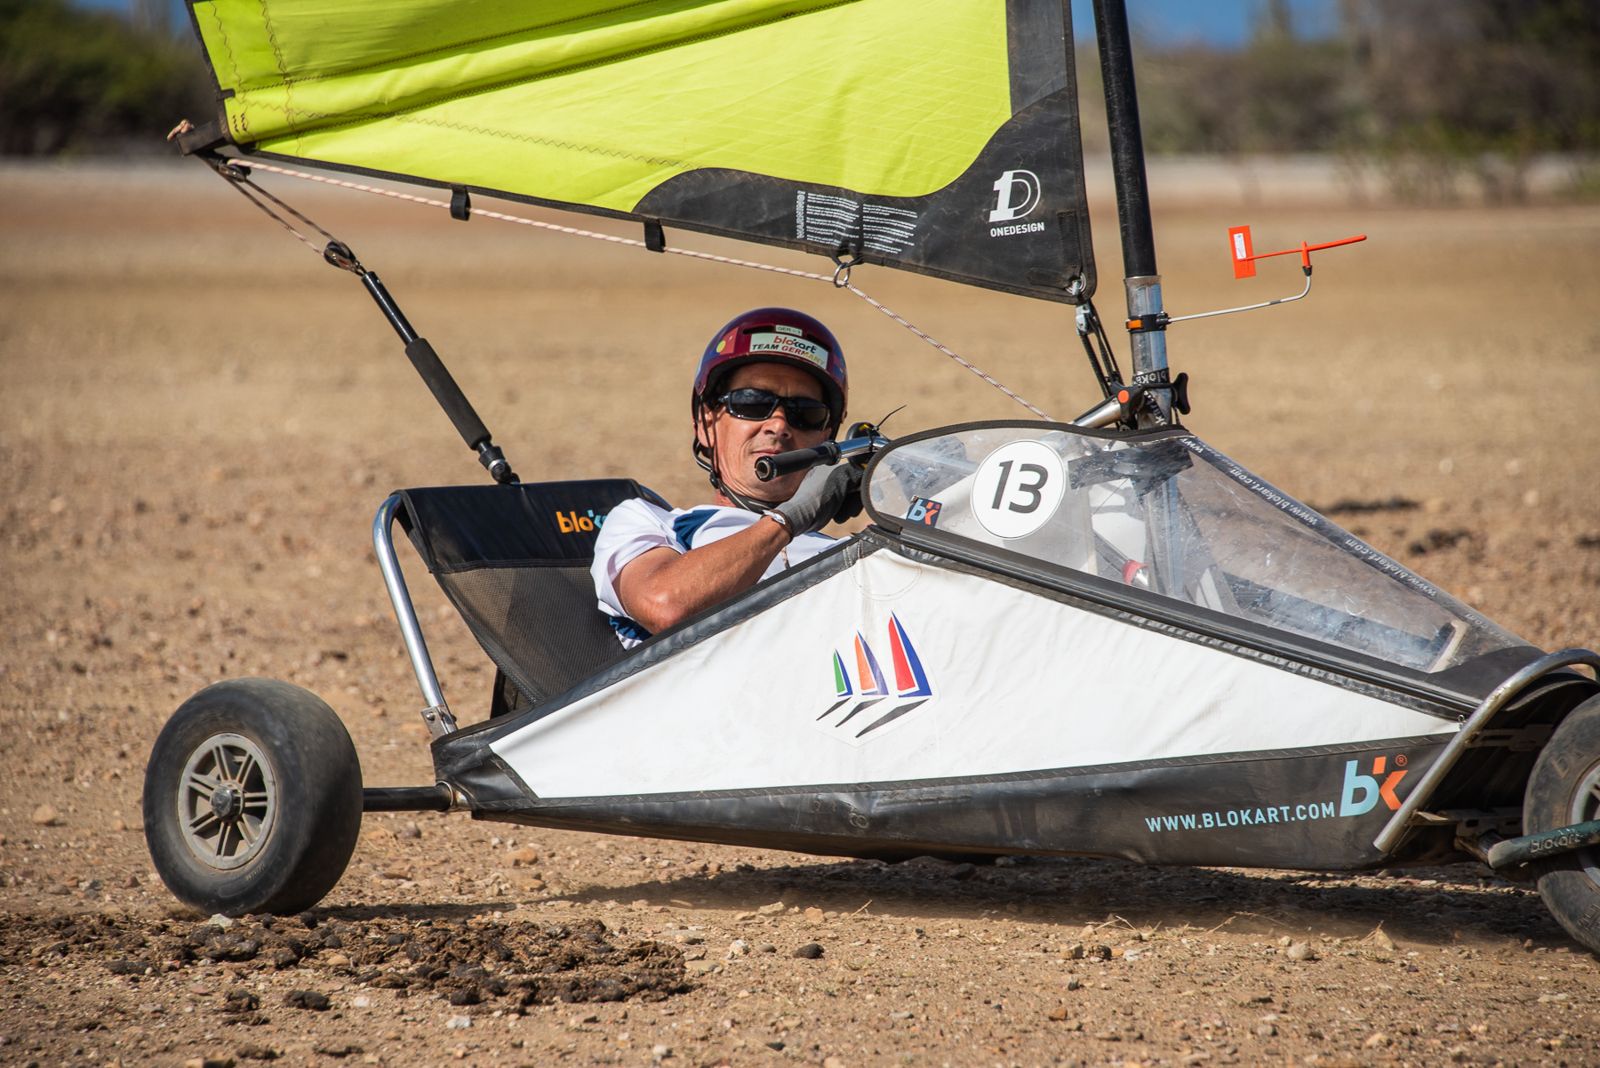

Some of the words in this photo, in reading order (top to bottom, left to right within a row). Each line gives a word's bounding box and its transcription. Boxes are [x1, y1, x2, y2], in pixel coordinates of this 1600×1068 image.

[990, 221, 1046, 238] ONEDESIGN
[773, 335, 818, 354] blokart
[781, 345, 825, 365] GERMANY
[991, 460, 1049, 514] 13
[1229, 467, 1319, 526] www.blokart.com
[1344, 537, 1438, 598] www.blokart.com
[1145, 801, 1336, 833] WWW.BLOKART.COM
